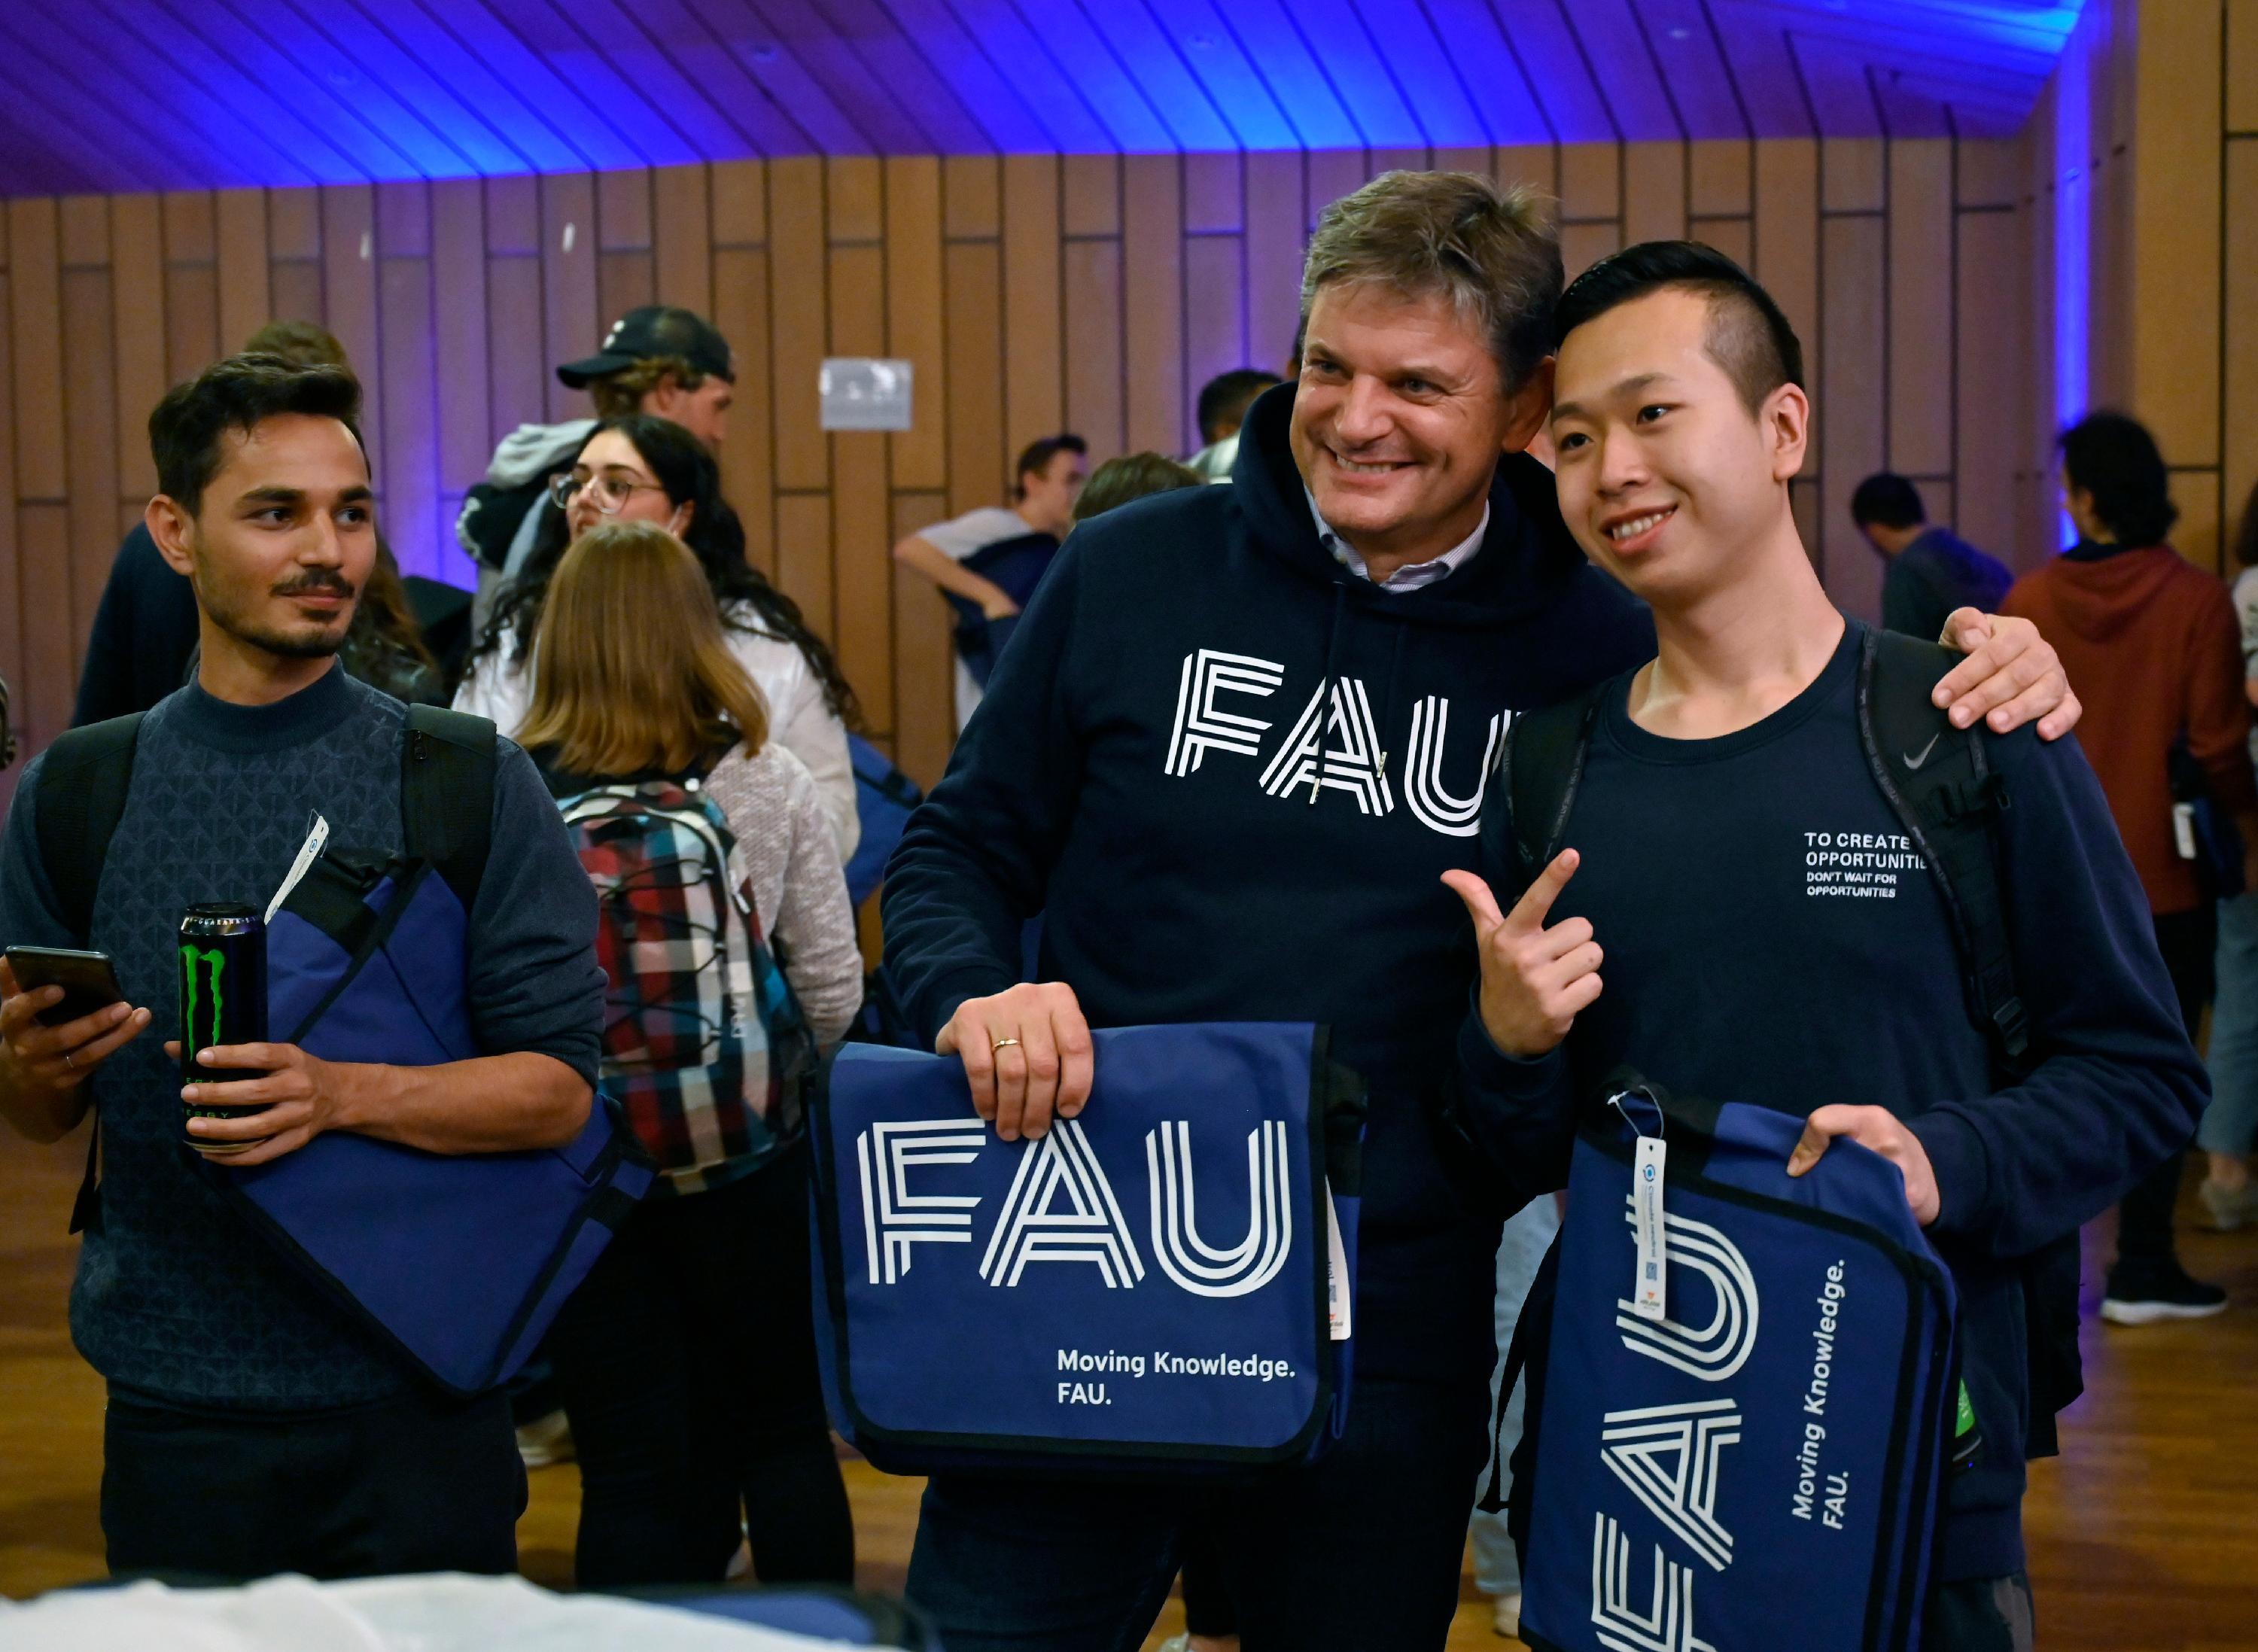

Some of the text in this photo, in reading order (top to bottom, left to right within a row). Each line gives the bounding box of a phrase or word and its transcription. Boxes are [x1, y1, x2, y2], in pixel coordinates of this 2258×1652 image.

[1164, 648, 1522, 837] FAU
[1803, 832, 1910, 850] TO CREATE
[1806, 851, 1928, 869] OPPORTUNITIE
[1806, 871, 1897, 885] DON'T WAIT FOR
[1806, 885, 1896, 899] OPPORTUNITIES
[857, 1118, 1292, 1298] FAU
[1057, 1349, 1296, 1381] Moving Knowledge.
[1057, 1383, 1112, 1406] FAU.
[1791, 1259, 1846, 1521] Moving Knowledge.
[1591, 1194, 1759, 1652] FAU
[1822, 1471, 1849, 1530] FAU.
